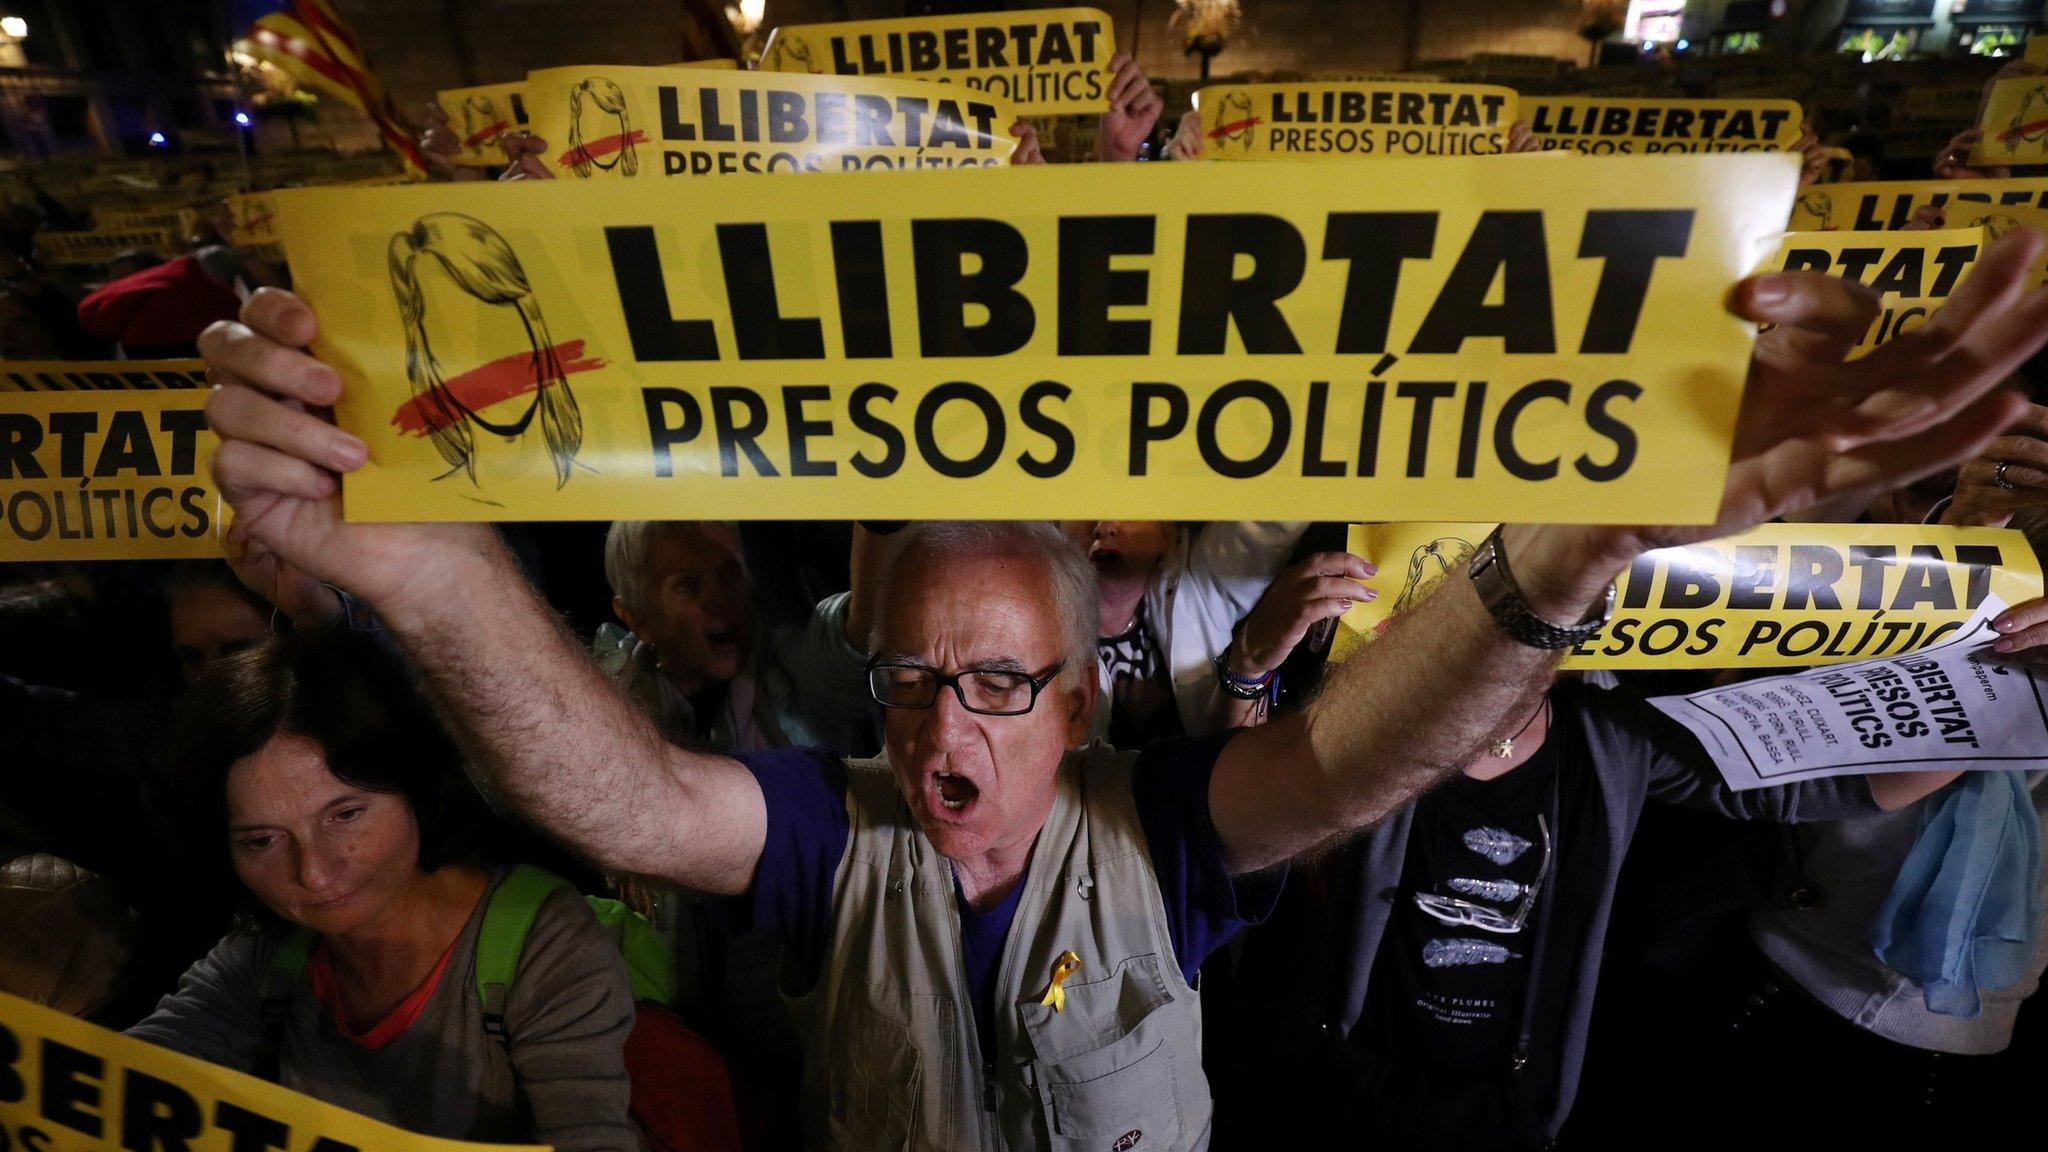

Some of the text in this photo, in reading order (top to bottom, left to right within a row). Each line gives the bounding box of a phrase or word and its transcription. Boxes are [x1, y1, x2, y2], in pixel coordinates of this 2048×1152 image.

[830, 21, 1101, 75] LLIBERTAT
[658, 86, 997, 150] LLIBERTAT
[1272, 91, 1505, 127] LLIBERTAT
[1532, 106, 1790, 140] LLIBERTAT
[1270, 125, 1503, 156] PRESOS POLÍTICS
[604, 207, 1696, 362] LLIBERTAT
[641, 352, 1644, 482] PRESOS POLÍTICS
[0, 476, 210, 541] OLÍTICS
